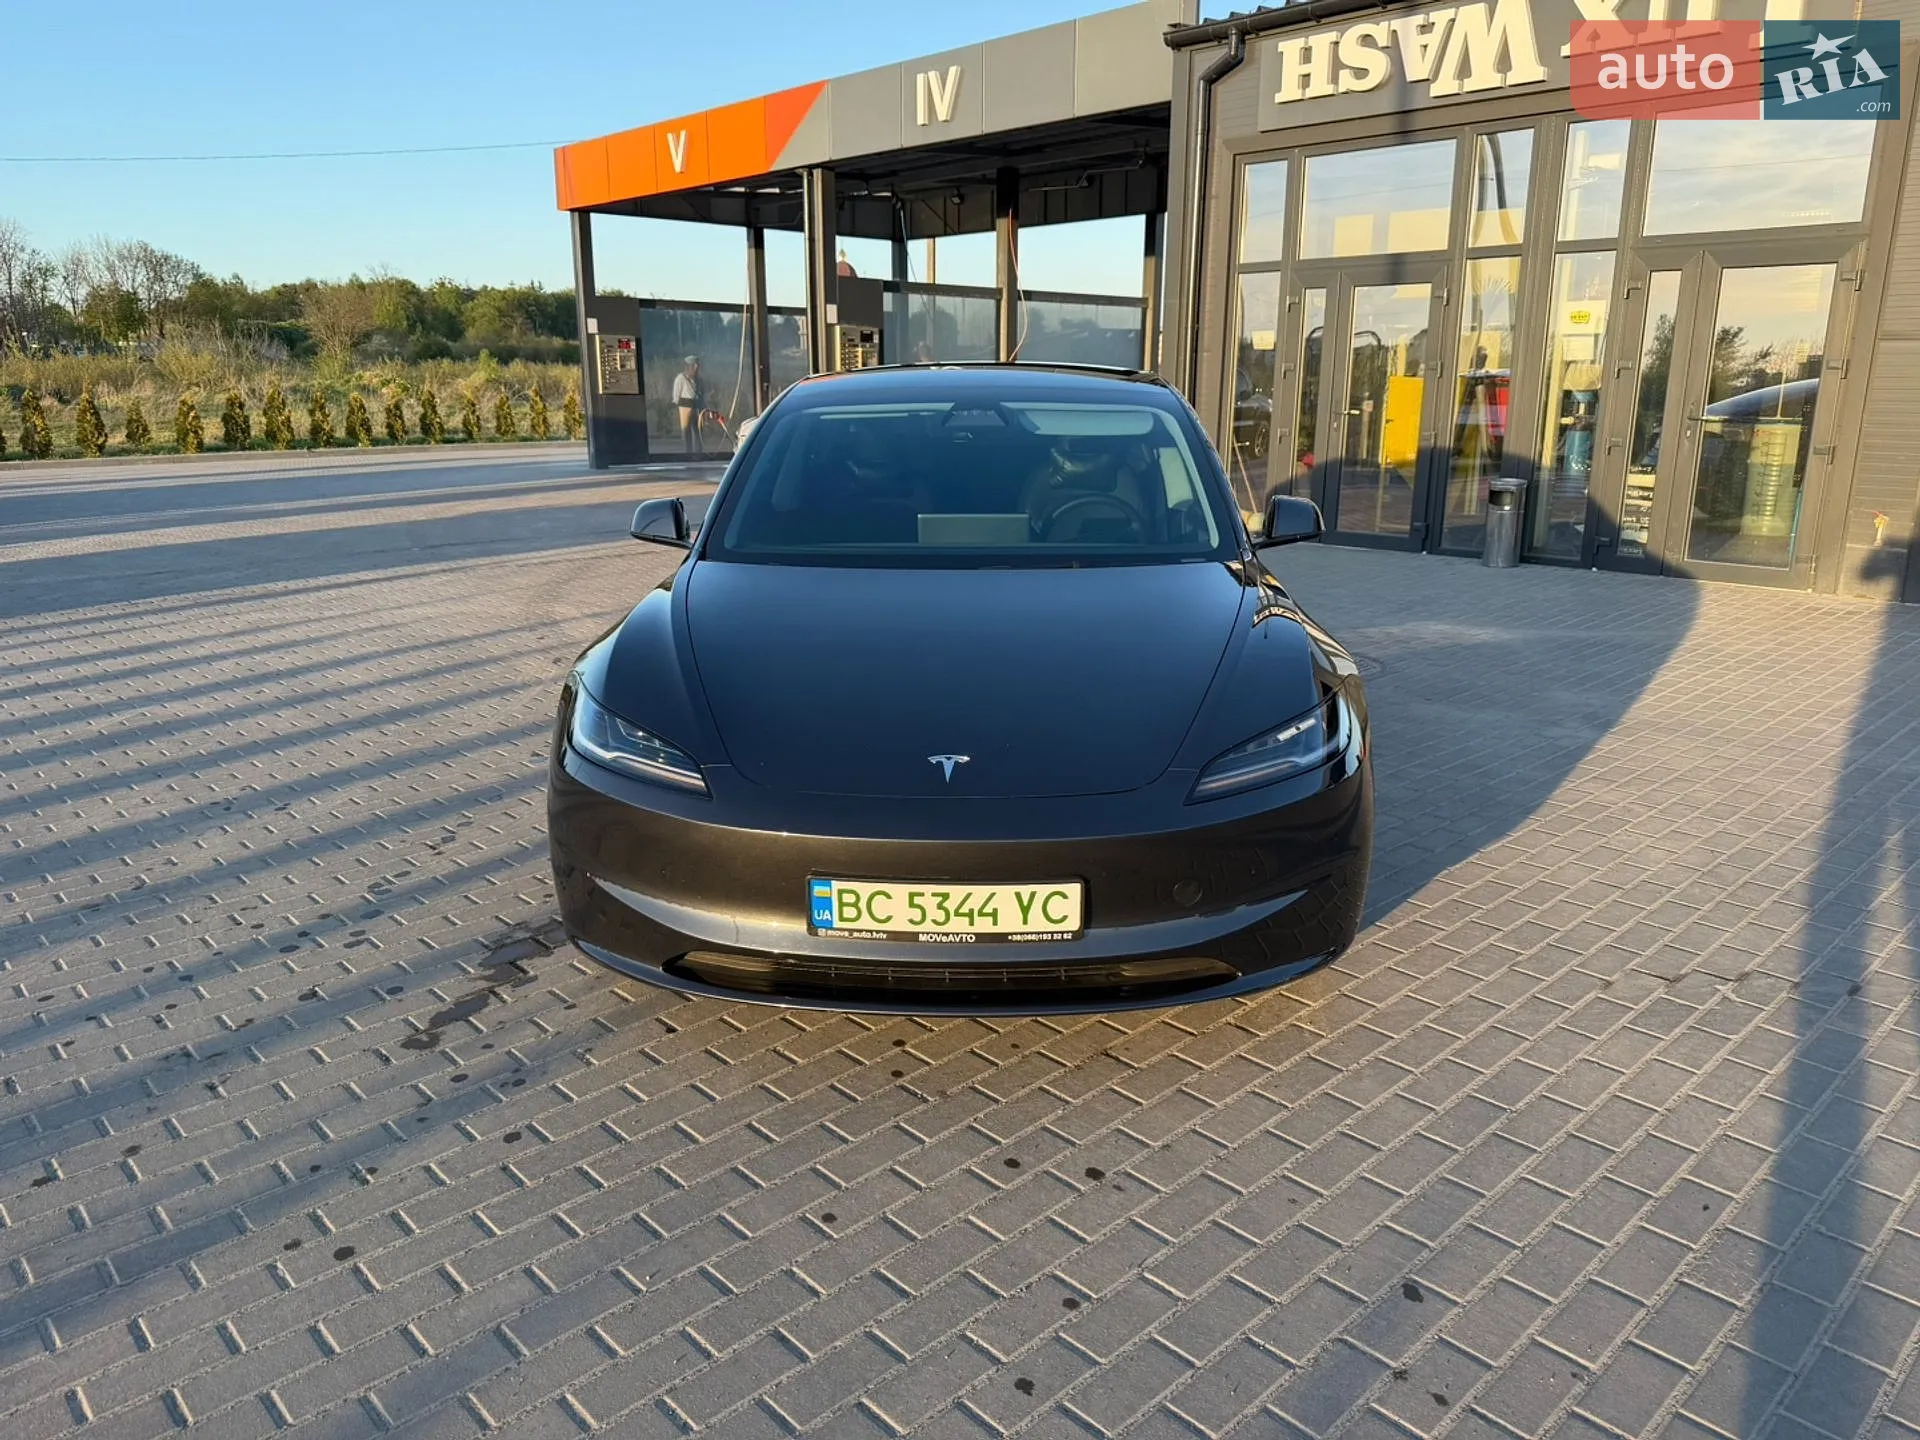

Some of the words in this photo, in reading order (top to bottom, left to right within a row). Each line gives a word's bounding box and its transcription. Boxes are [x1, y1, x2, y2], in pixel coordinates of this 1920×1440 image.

[1275, 3, 1549, 103] WASH
[916, 65, 961, 127] IV
[666, 129, 687, 174] V
[814, 908, 832, 921] UA
[836, 888, 893, 923] BC
[907, 891, 998, 926] 5344
[1014, 890, 1069, 925] YC
